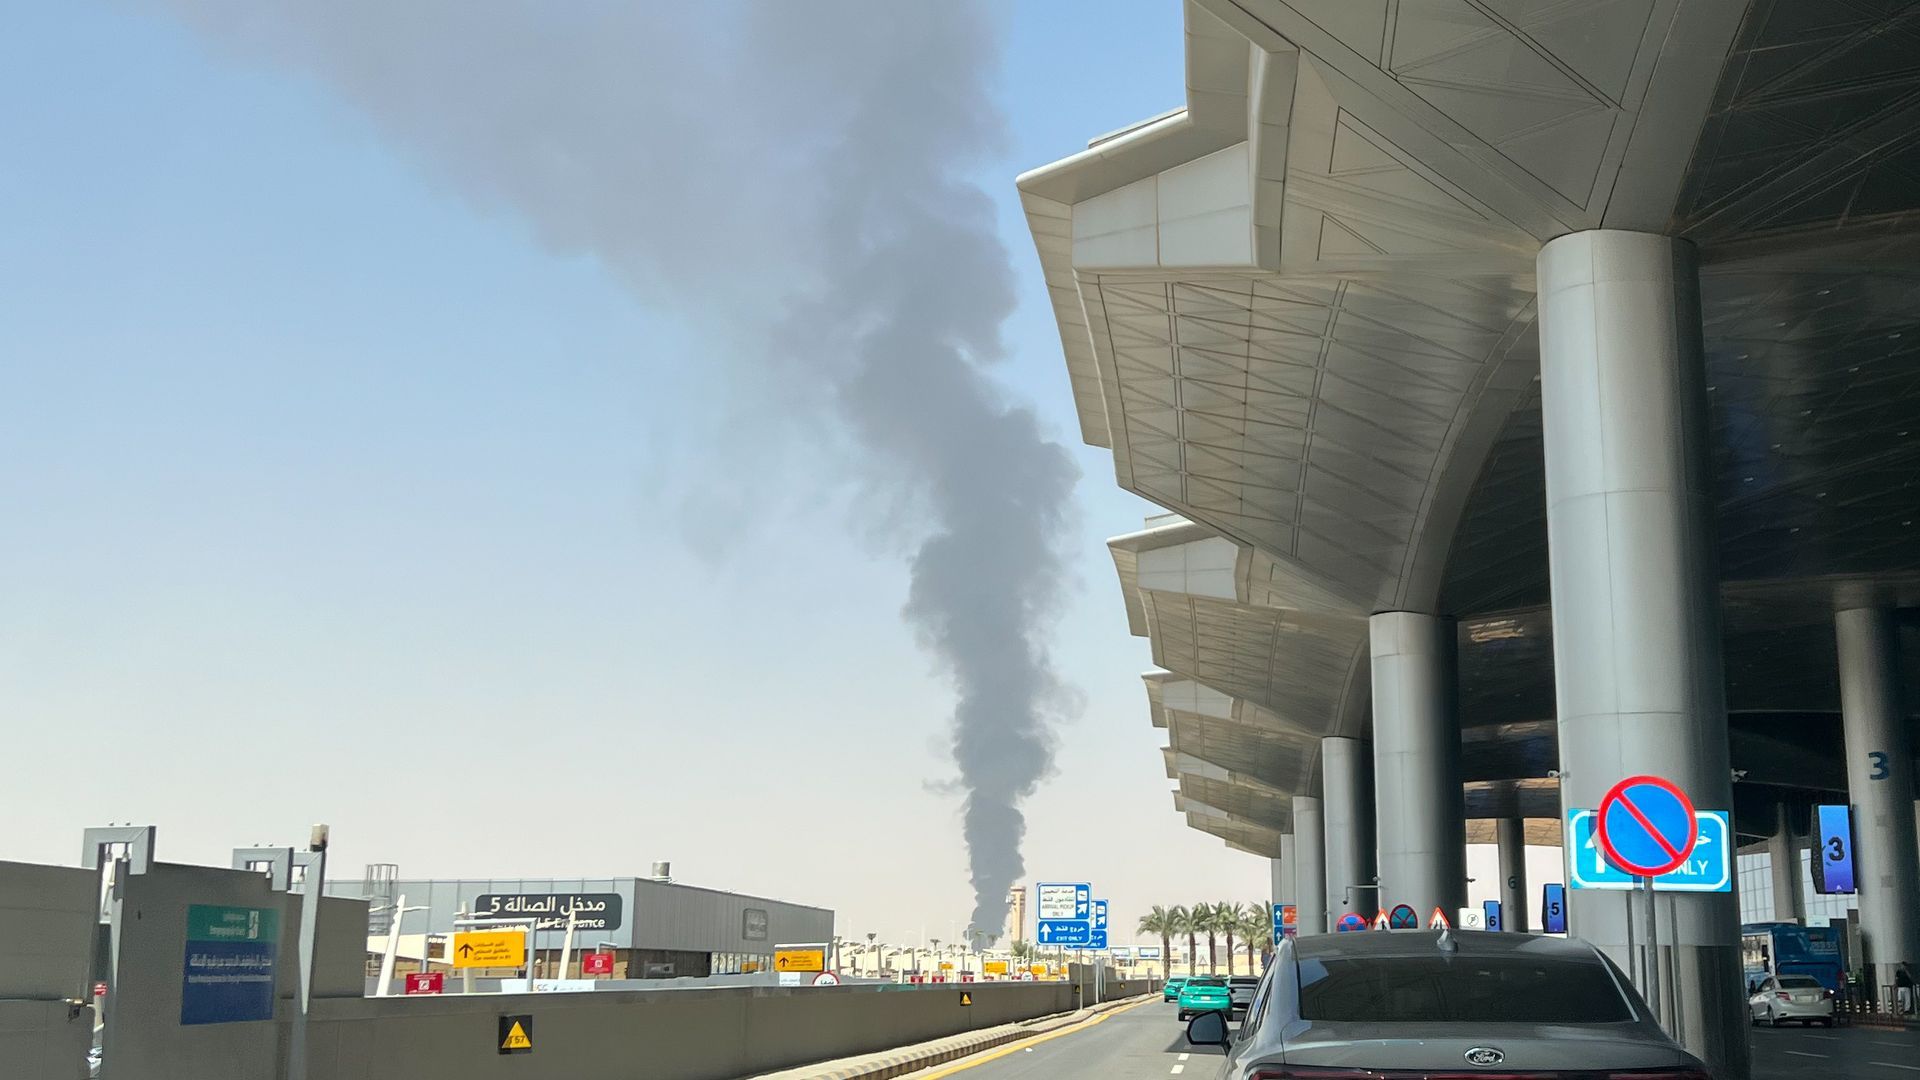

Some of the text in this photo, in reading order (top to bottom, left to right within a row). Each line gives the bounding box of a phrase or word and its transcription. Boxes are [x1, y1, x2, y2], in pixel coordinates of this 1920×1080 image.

[1868, 752, 1889, 780] 3
[1828, 836, 1845, 862] 3
[1672, 860, 1708, 875] NLY
[490, 896, 606, 916] مدخل الصالة 5
[1551, 902, 1560, 915] 5
[554, 918, 606, 929] Enance
[1489, 915, 1497, 927] 6
[1473, 1052, 1496, 1063] Ford
